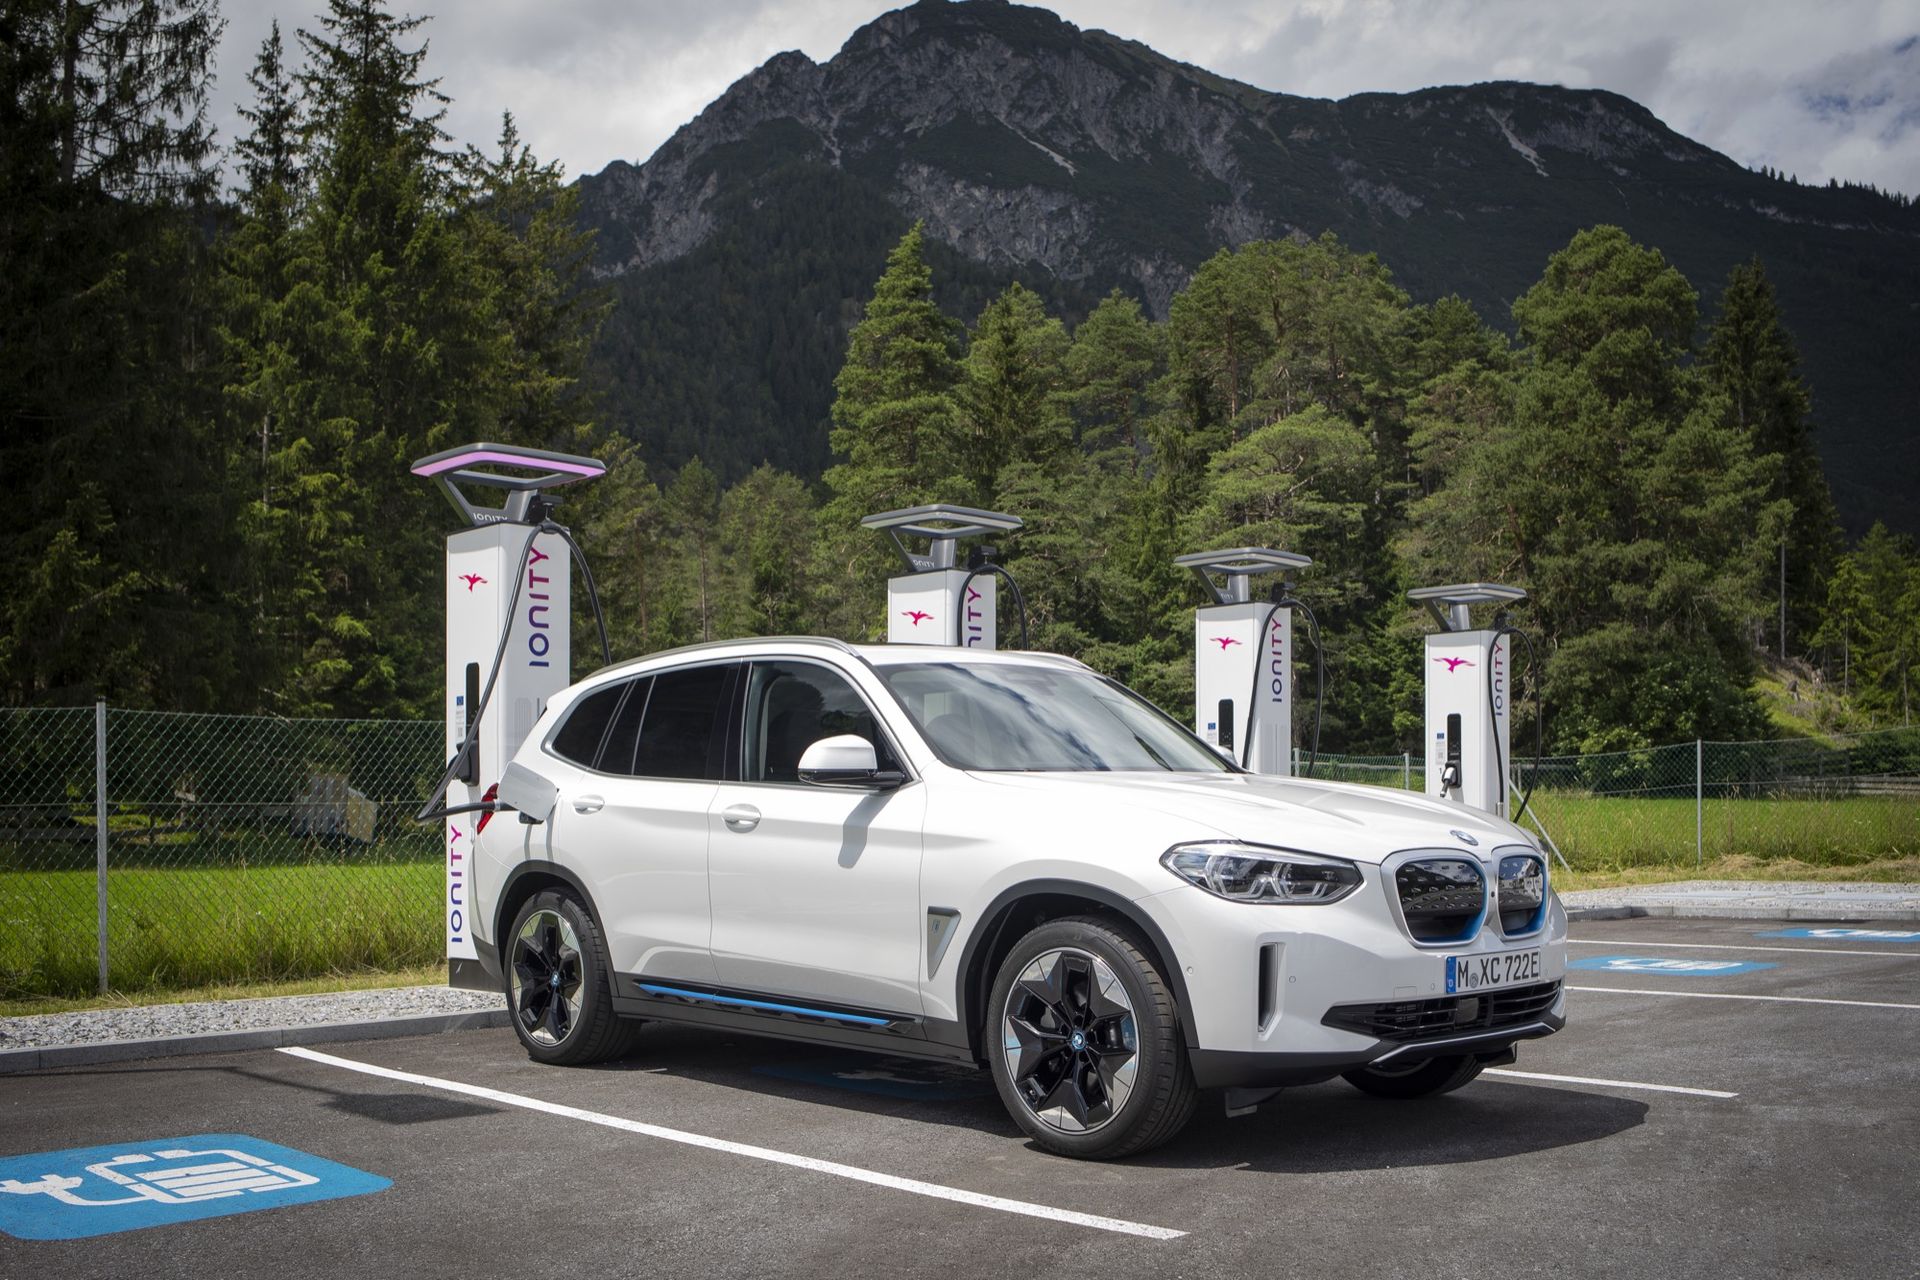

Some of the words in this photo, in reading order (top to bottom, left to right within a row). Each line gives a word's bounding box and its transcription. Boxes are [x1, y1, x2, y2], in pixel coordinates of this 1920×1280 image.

[528, 546, 550, 667] IONITY
[1271, 617, 1283, 704] IONITY
[1495, 642, 1503, 716] IONITY
[450, 824, 463, 943] IONITY
[1448, 979, 1454, 988] D
[1457, 960, 1469, 988] M
[1480, 957, 1501, 986] XC
[1504, 952, 1539, 982] 722E
